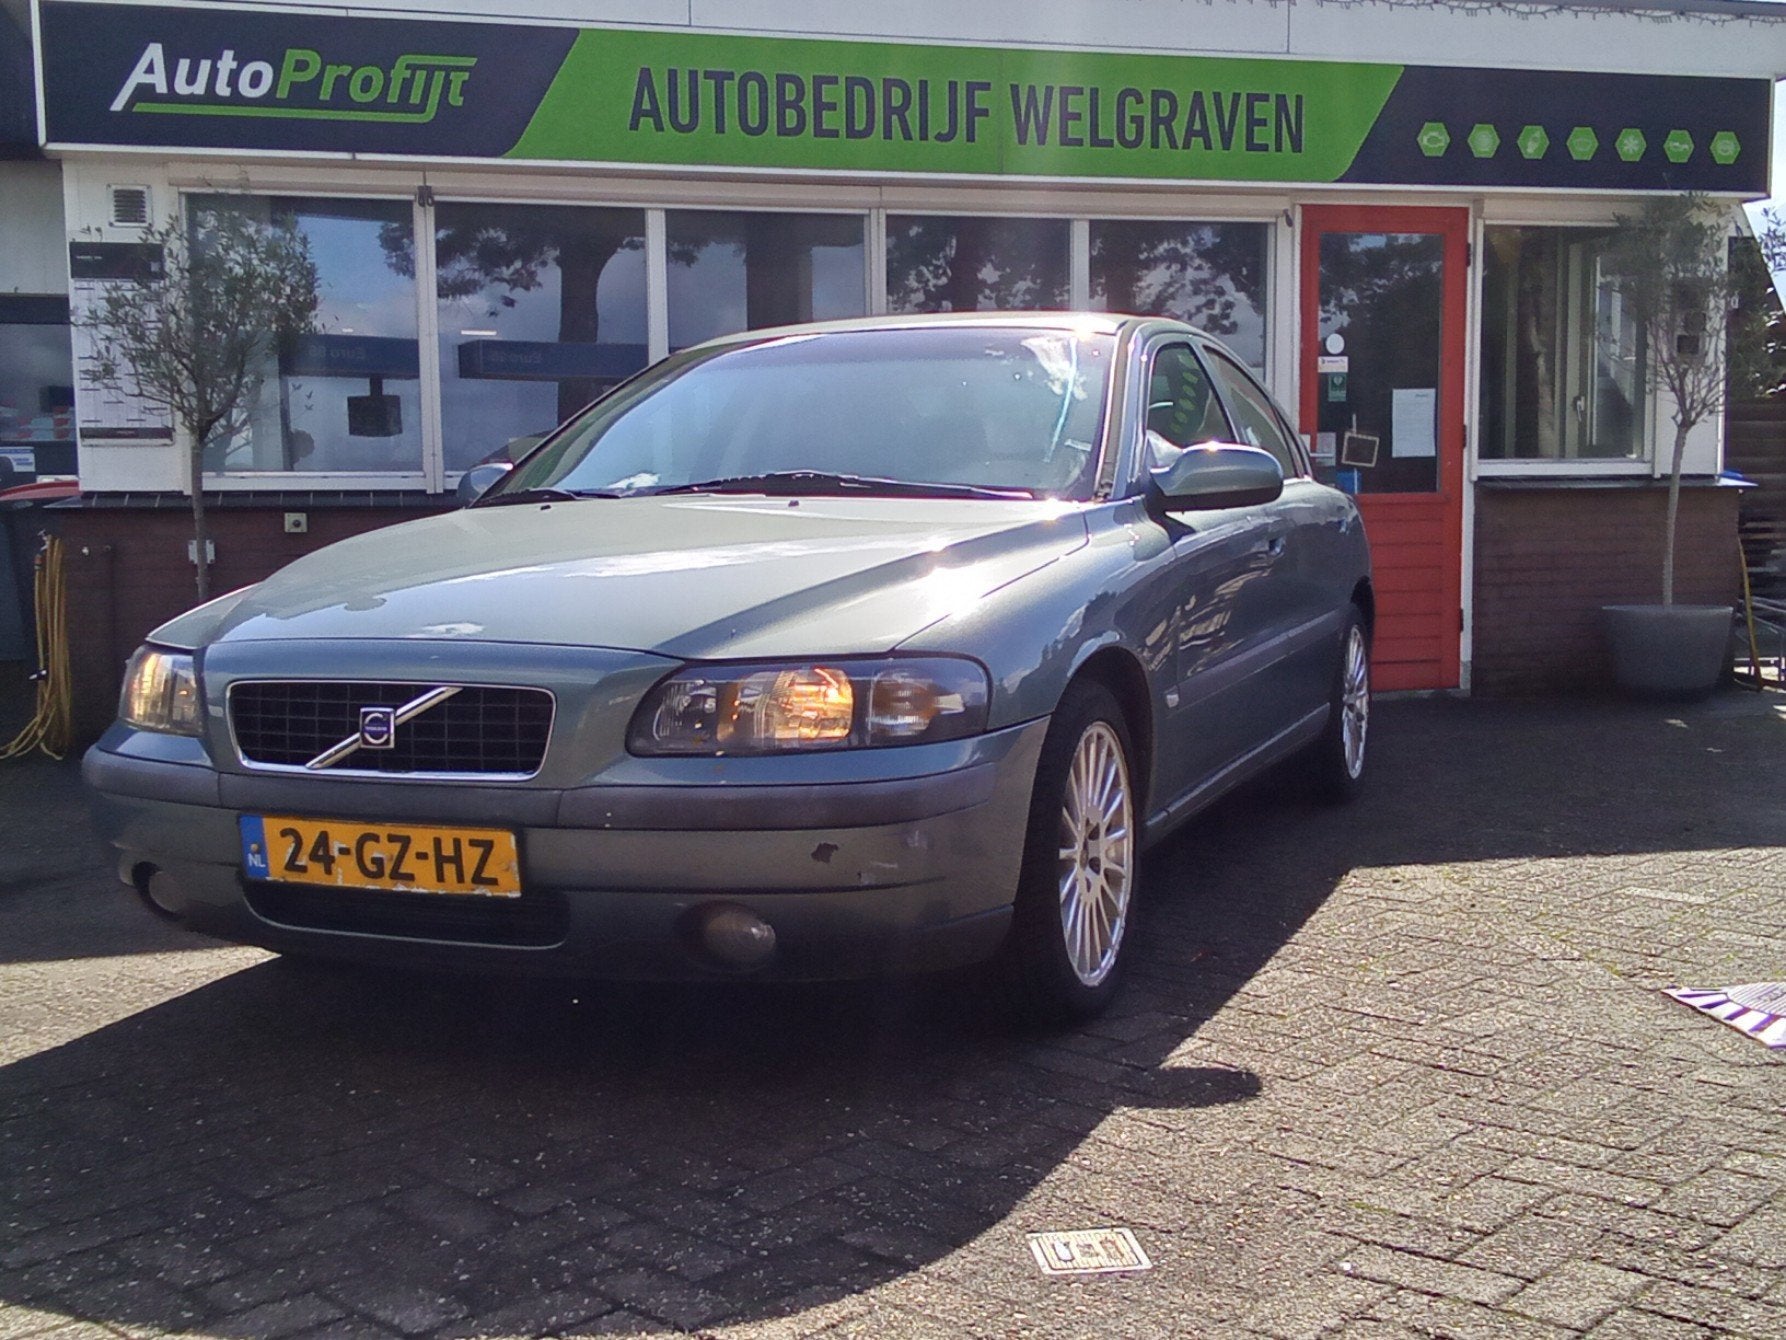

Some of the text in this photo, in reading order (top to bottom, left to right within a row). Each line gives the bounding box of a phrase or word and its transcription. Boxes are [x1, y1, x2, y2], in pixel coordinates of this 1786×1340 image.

[109, 42, 478, 123] AutoProfijt
[628, 67, 1303, 153] AUTOBEDRIJF WELGRAVEN
[248, 852, 266, 868] NL
[279, 827, 499, 886] 24-GZ-HZ
